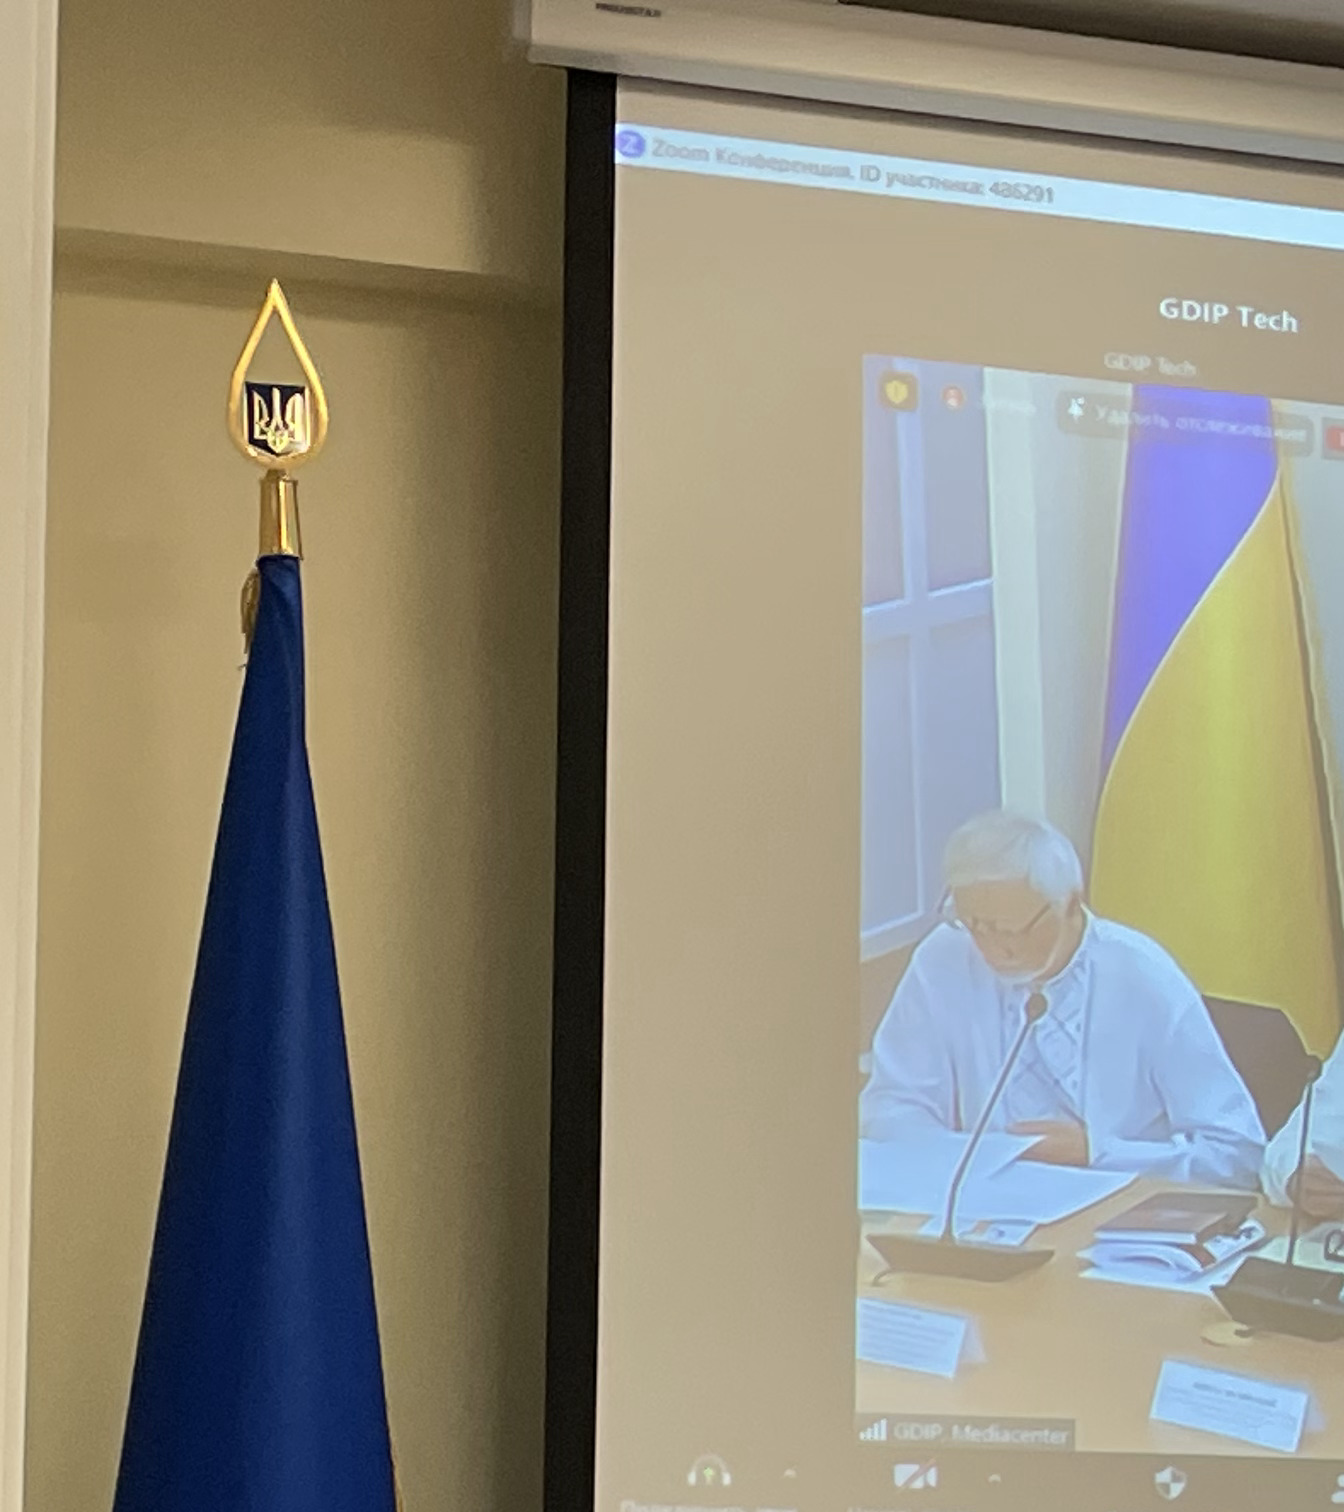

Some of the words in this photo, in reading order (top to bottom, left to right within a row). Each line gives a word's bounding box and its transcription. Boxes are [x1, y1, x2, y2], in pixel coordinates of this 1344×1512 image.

[652, 138, 710, 163] Zoom
[860, 165, 882, 183] ID
[1158, 297, 1230, 324] GDIP
[1236, 305, 1299, 333] Tech
[1103, 351, 1151, 373] GDIP
[1156, 355, 1198, 378] Tech
